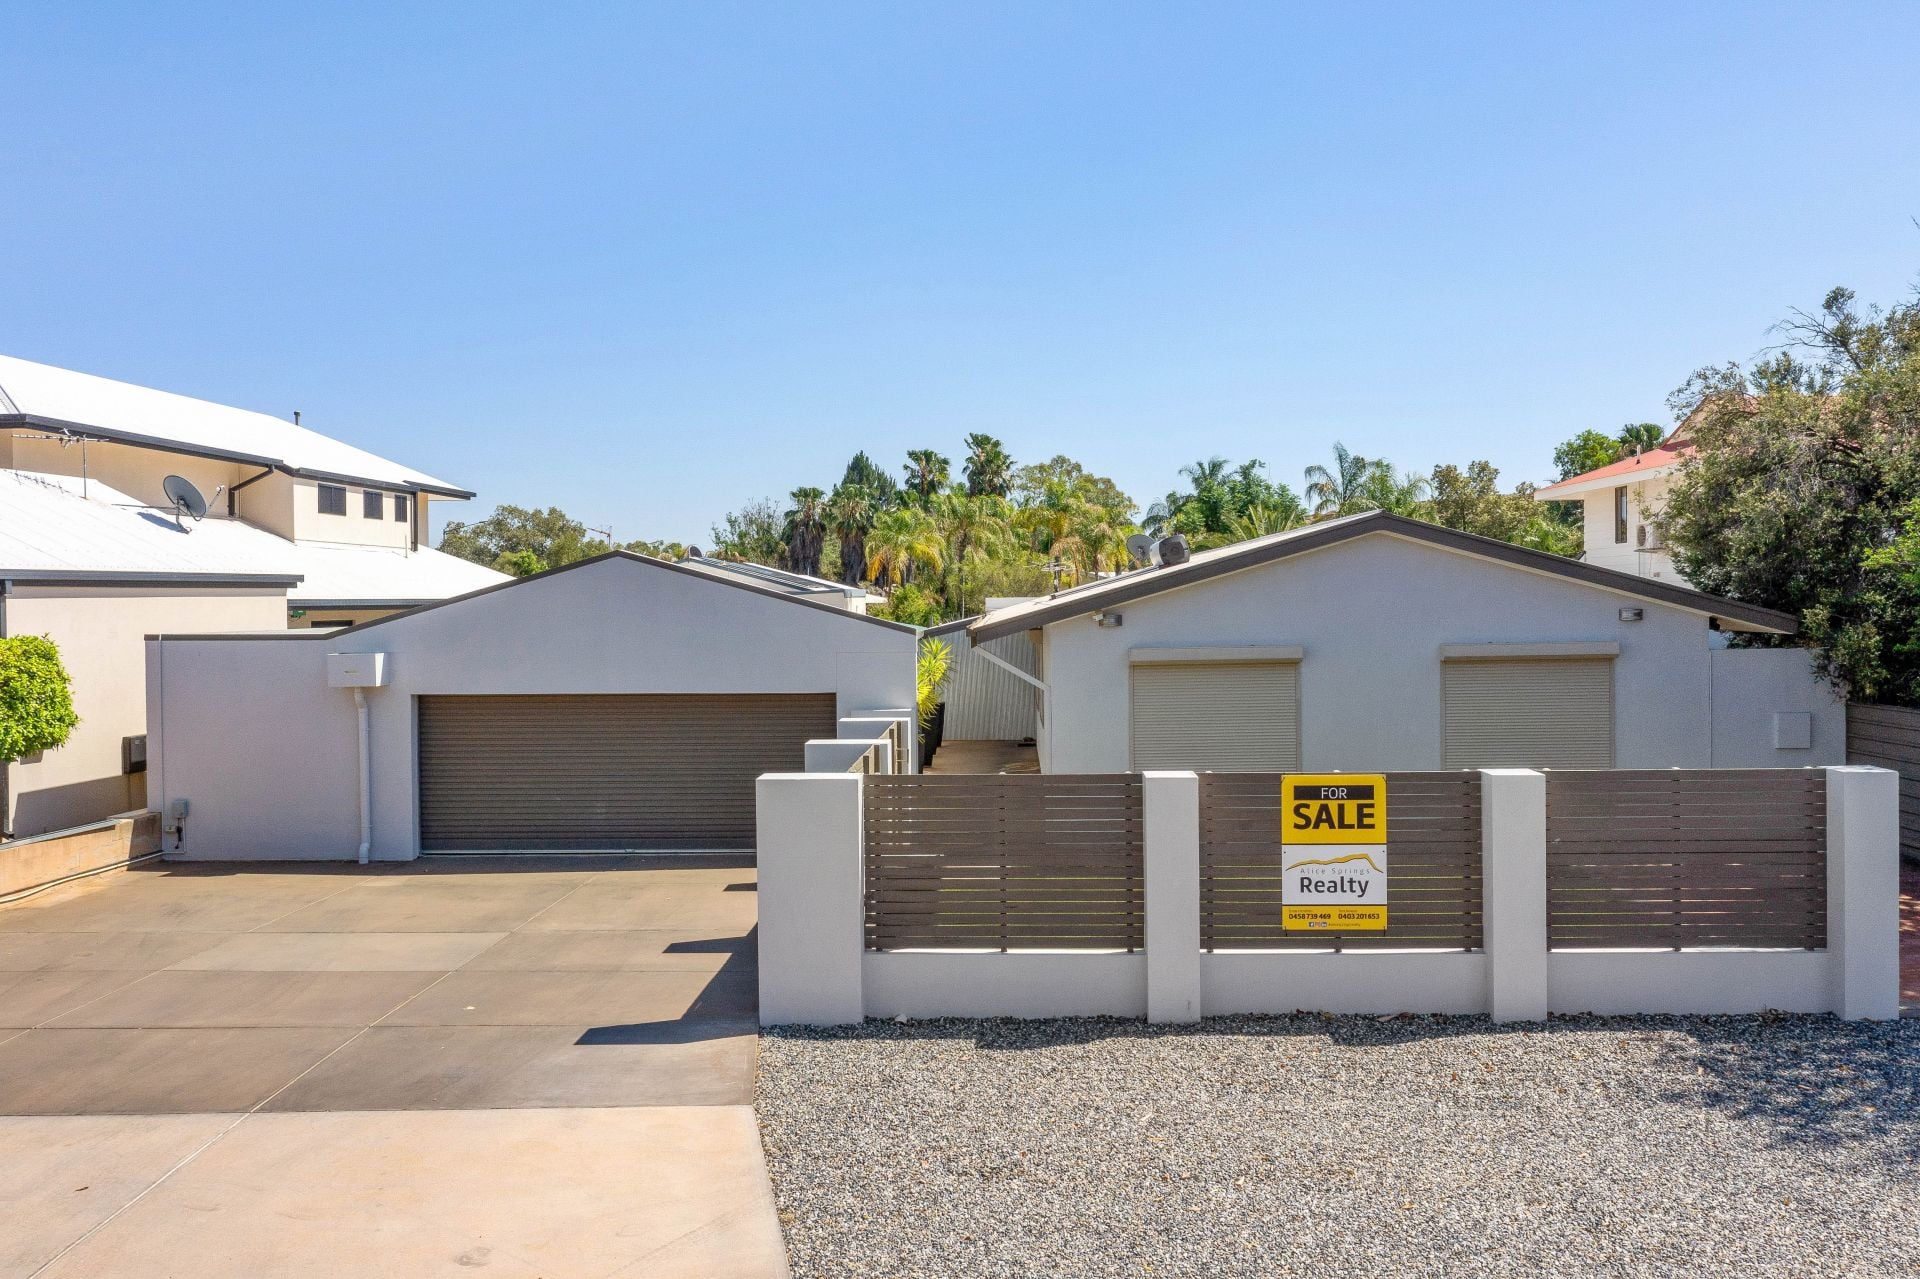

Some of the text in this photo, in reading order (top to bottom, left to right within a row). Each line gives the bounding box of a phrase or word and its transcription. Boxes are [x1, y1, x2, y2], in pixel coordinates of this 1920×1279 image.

[1321, 787, 1347, 799] FOR
[1293, 803, 1375, 830] SALE
[1300, 876, 1369, 898] Realty
